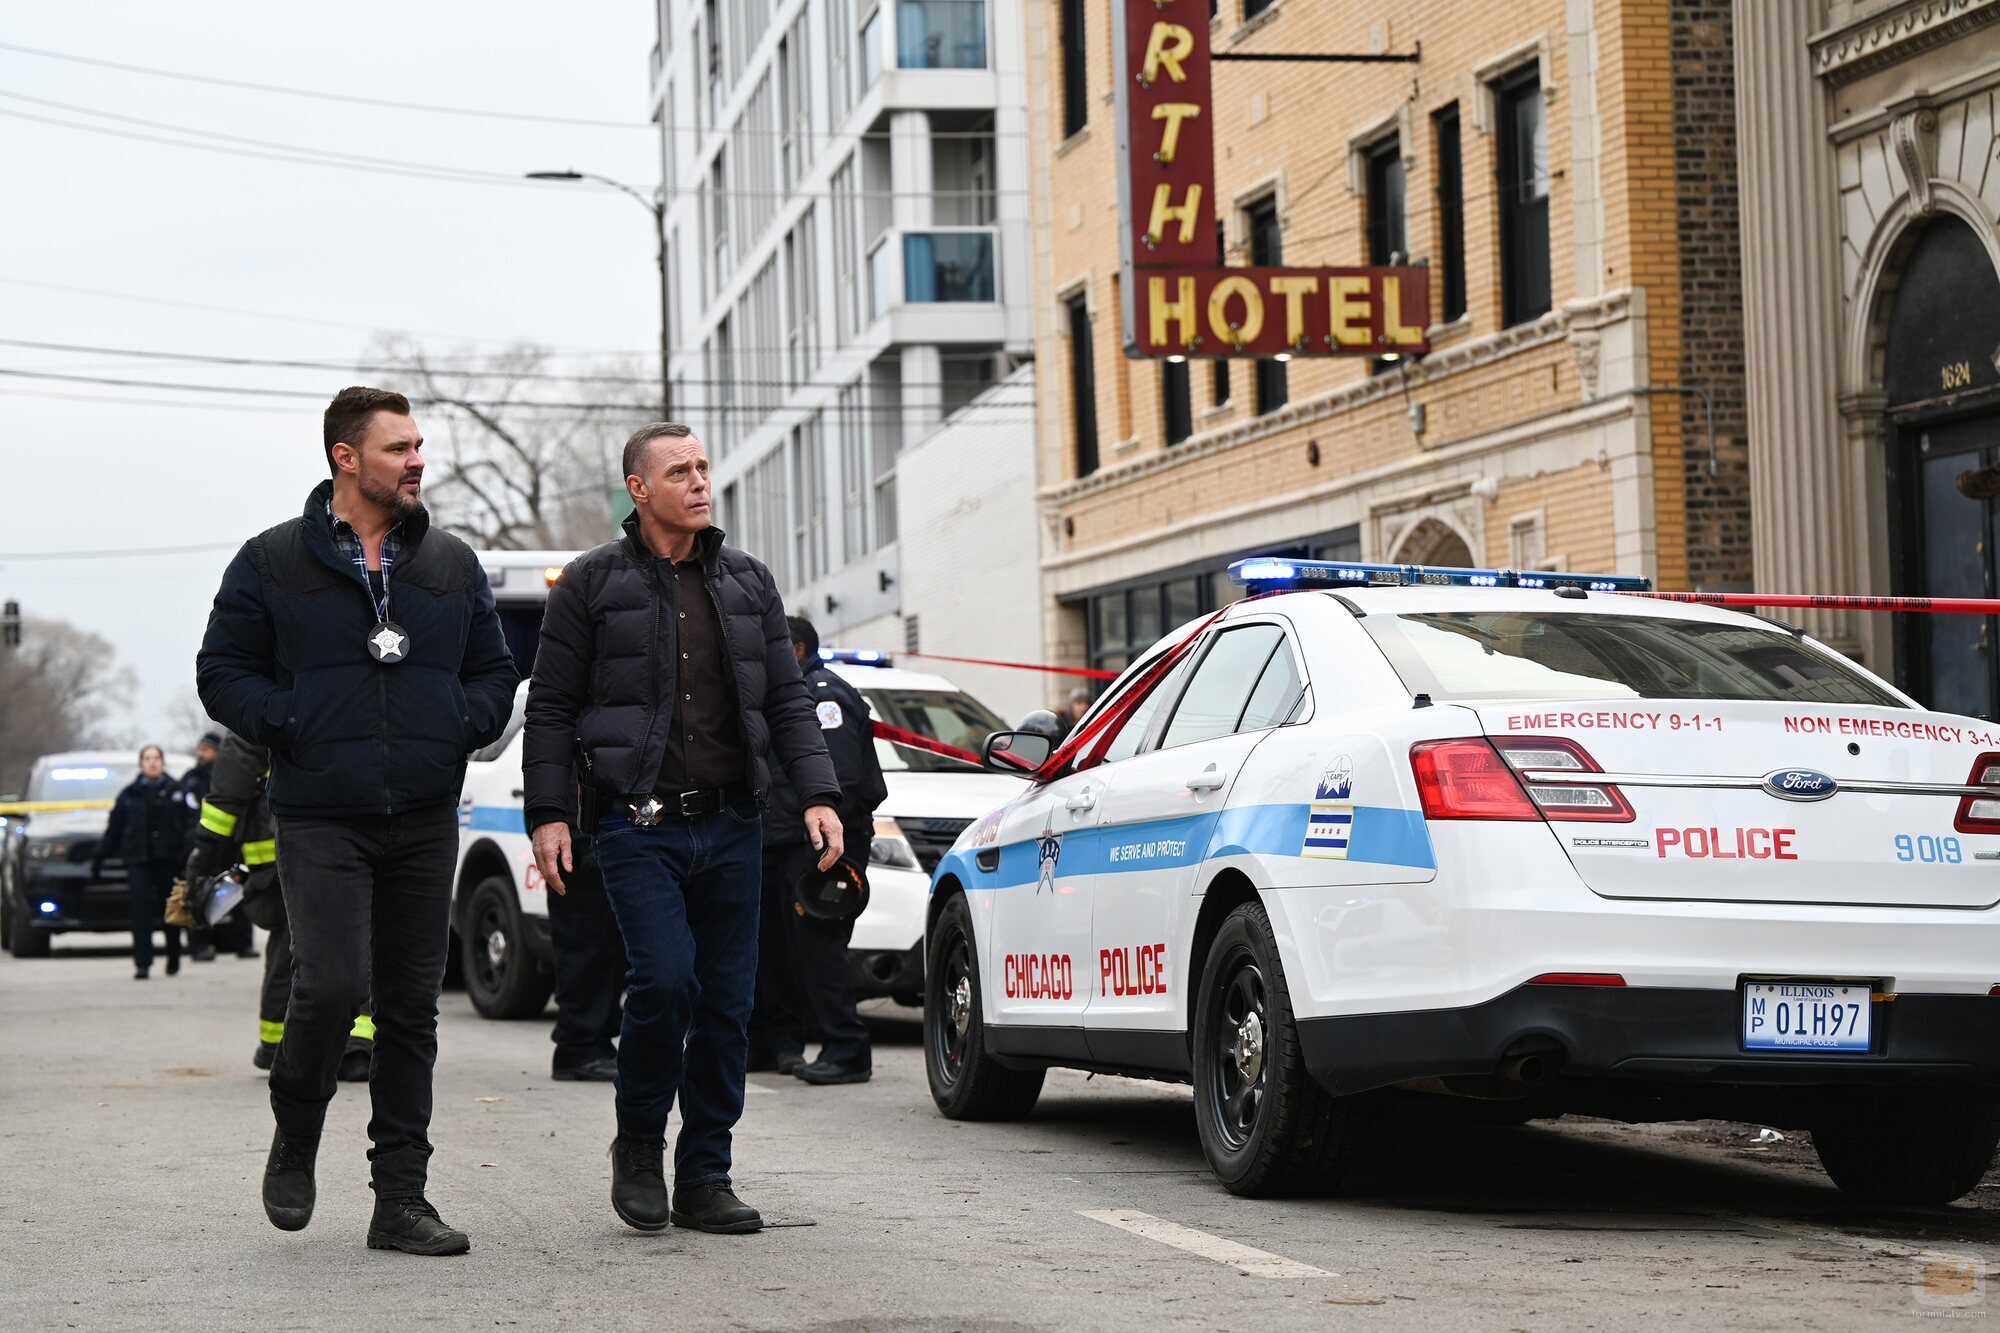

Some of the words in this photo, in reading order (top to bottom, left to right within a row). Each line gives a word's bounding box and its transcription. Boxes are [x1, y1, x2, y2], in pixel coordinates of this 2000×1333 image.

[1143, 0, 1203, 244] RTH
[1148, 276, 1424, 346] HOTEL
[1941, 360, 1971, 390] 1624
[1507, 712, 1662, 731] EMERGENCY
[1669, 714, 1723, 732] 9-1-1
[1784, 716, 1831, 734] NON
[1838, 718, 1962, 744] EMERGENCY
[1967, 730, 2000, 747] 3-1-
[1330, 773, 1344, 781] CAPS
[1782, 772, 1822, 790] Ford
[1109, 846, 1120, 863] WE
[1120, 844, 1142, 861] SERVE
[1141, 842, 1156, 859] AND
[1157, 839, 1186, 857] PROTECT
[1655, 827, 1798, 860] POLICE
[1894, 834, 1963, 864] 9019
[1004, 953, 1073, 1001] CHICAGO
[1100, 943, 1167, 997] POLICE
[1780, 986, 1835, 999] ILLINOIS
[1776, 1002, 1860, 1036] 01H97
[1774, 1038, 1813, 1046] MUNICIPAL
[1813, 1039, 1838, 1047] POLICE
